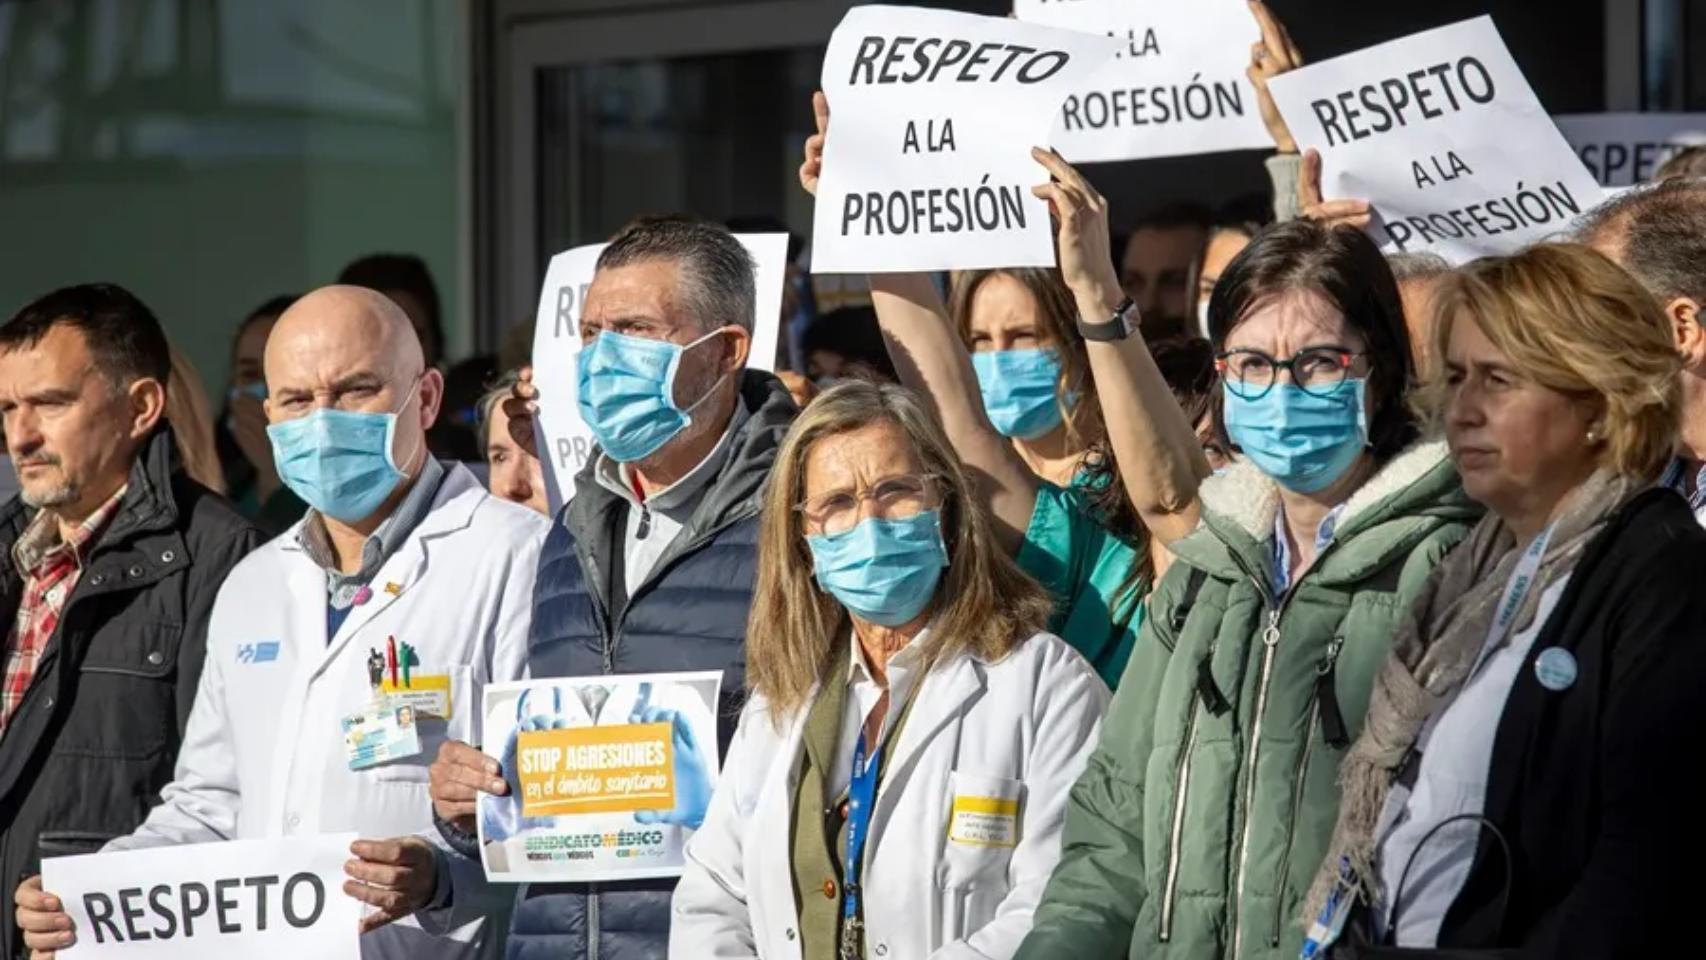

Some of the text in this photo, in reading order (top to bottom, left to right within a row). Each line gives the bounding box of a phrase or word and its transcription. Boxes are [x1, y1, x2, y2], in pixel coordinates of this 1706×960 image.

[849, 35, 1070, 85] RESPETO
[1129, 27, 1160, 57] LA
[1062, 72, 1244, 131] ROFESIÓN
[1311, 56, 1496, 147] RESPETO
[903, 118, 956, 154] A LA
[1411, 149, 1473, 189] A LA
[841, 174, 1026, 236] PROFESIÓN
[1384, 181, 1582, 251] PROFESIÓN
[521, 740, 666, 773] STOP AGRESIONES
[526, 782, 541, 800] en
[605, 770, 667, 795] sanitario
[83, 872, 326, 943] RESPETO
